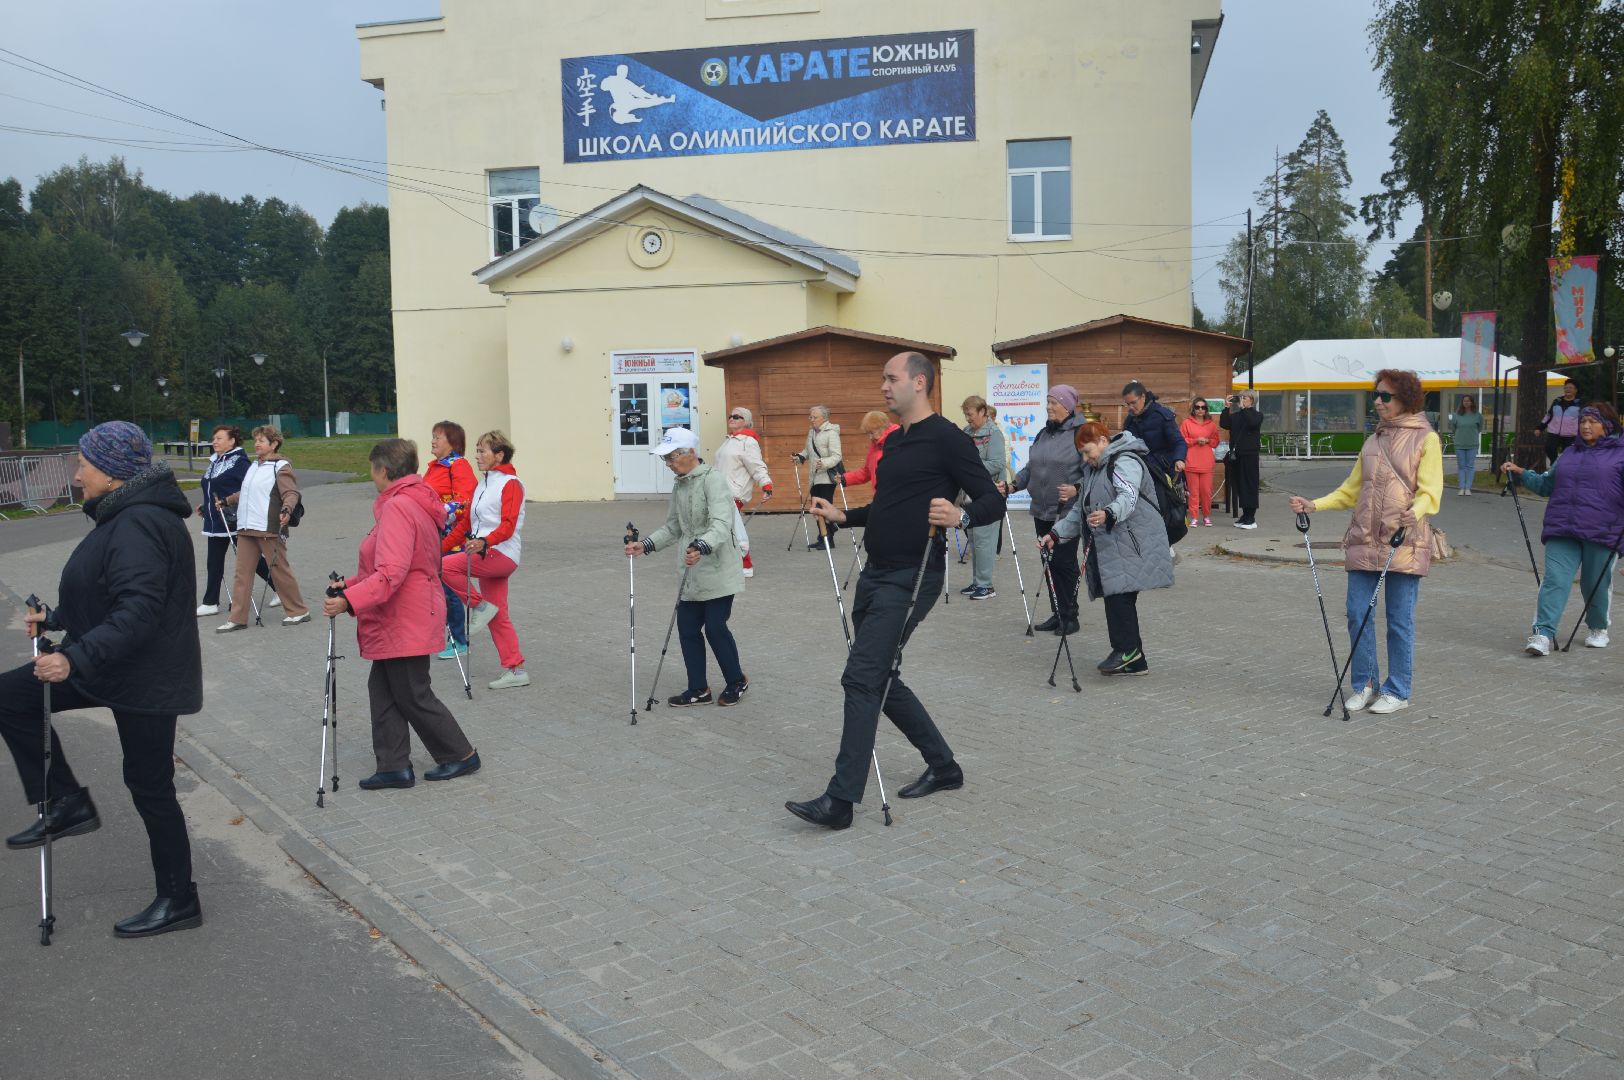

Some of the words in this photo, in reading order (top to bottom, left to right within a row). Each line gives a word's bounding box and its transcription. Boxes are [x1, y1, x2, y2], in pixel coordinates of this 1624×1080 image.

[872, 38, 959, 63] ЮЖНЫЙ
[728, 48, 871, 86] КАРАТЕ
[872, 63, 932, 77] СПОРТИВНЫЙ
[933, 63, 957, 74] КЛУБ
[578, 135, 662, 157] ШКОЛА
[669, 121, 872, 151] ОЛИМПИЙСКОГО
[880, 116, 966, 139] КАРАТЕ
[1571, 286, 1584, 329] МИРА
[624, 358, 656, 367] ЮЖНЫЙ
